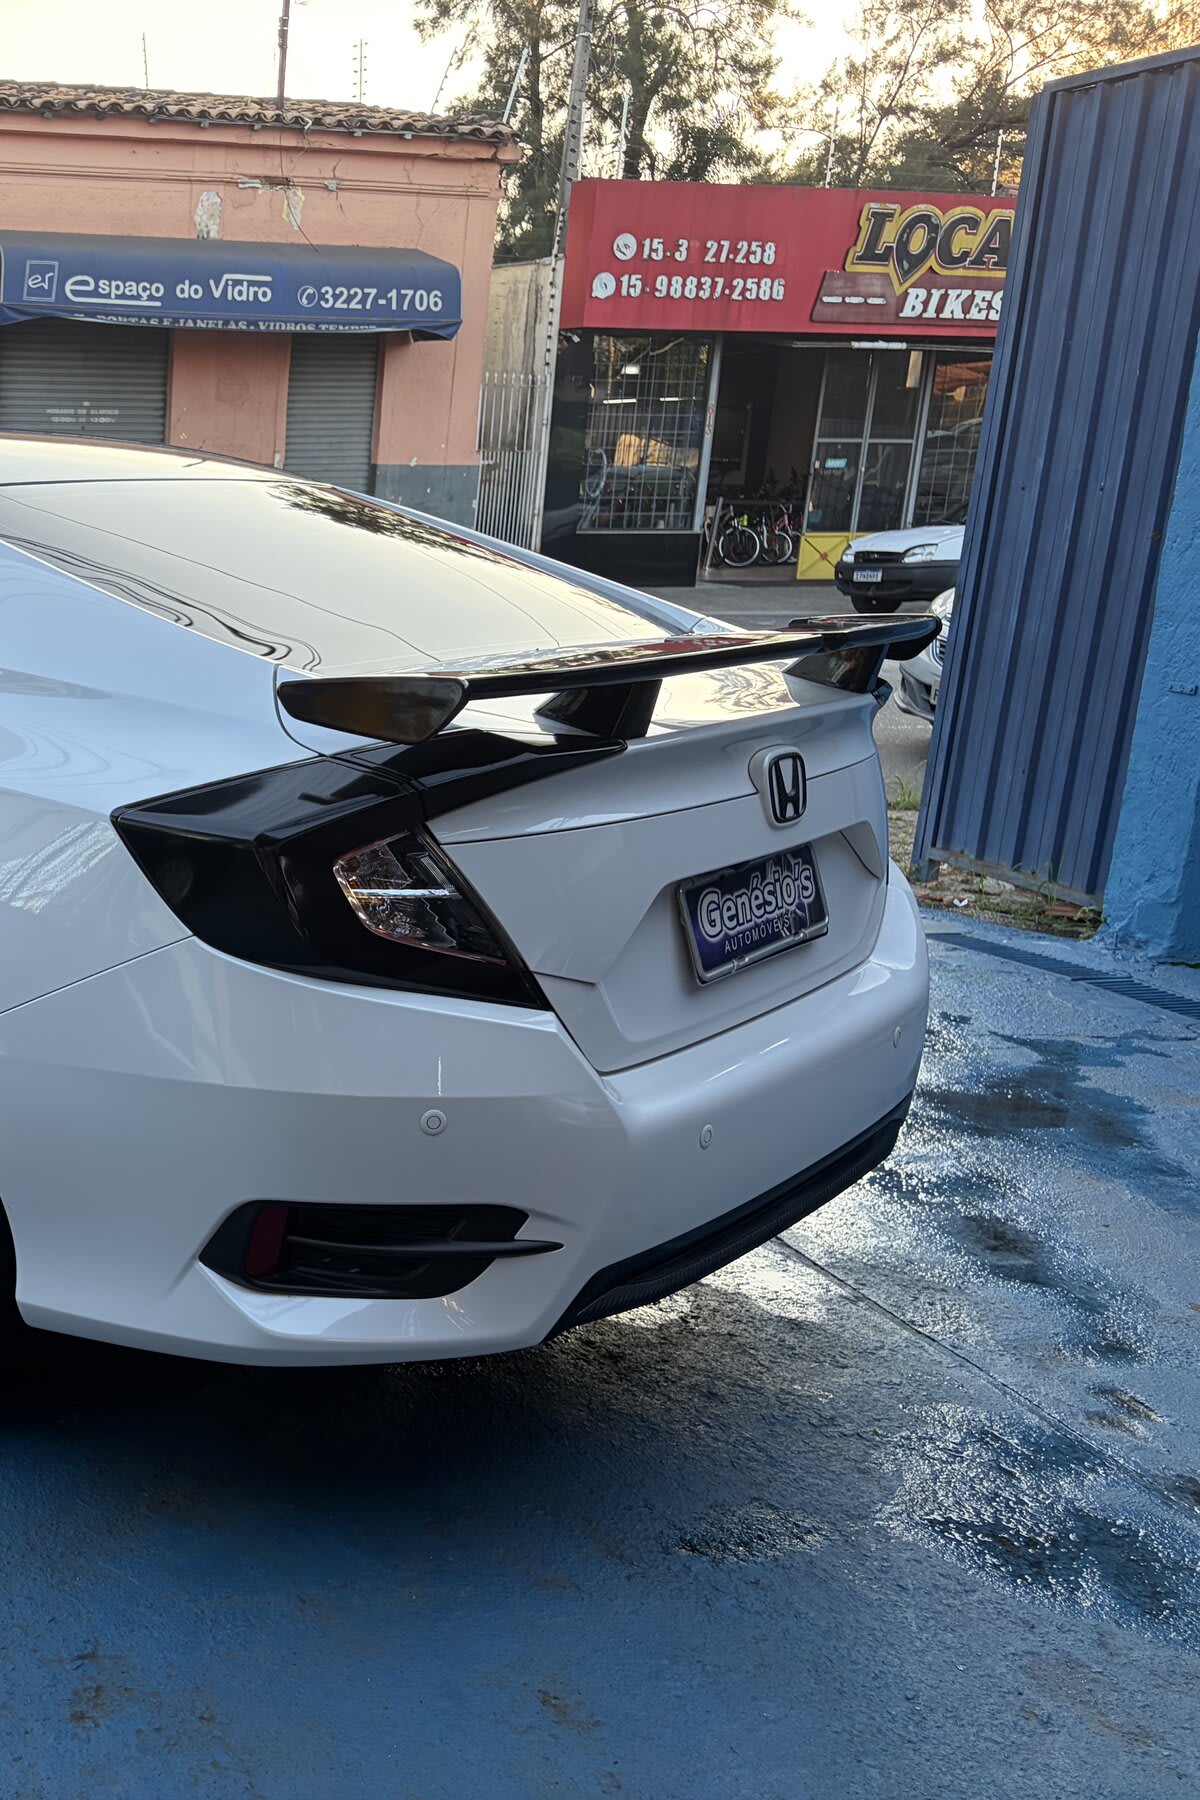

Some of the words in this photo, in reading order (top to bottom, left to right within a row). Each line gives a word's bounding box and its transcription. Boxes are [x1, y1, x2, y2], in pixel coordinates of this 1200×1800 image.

[63, 274, 163, 307] espaço
[175, 279, 204, 300] do
[208, 273, 274, 303] Vidro
[319, 285, 444, 312] 3227-1706
[898, 287, 1004, 321] BIKES
[174, 318, 248, 330] JANELAS
[700, 862, 815, 939] Genésio's
